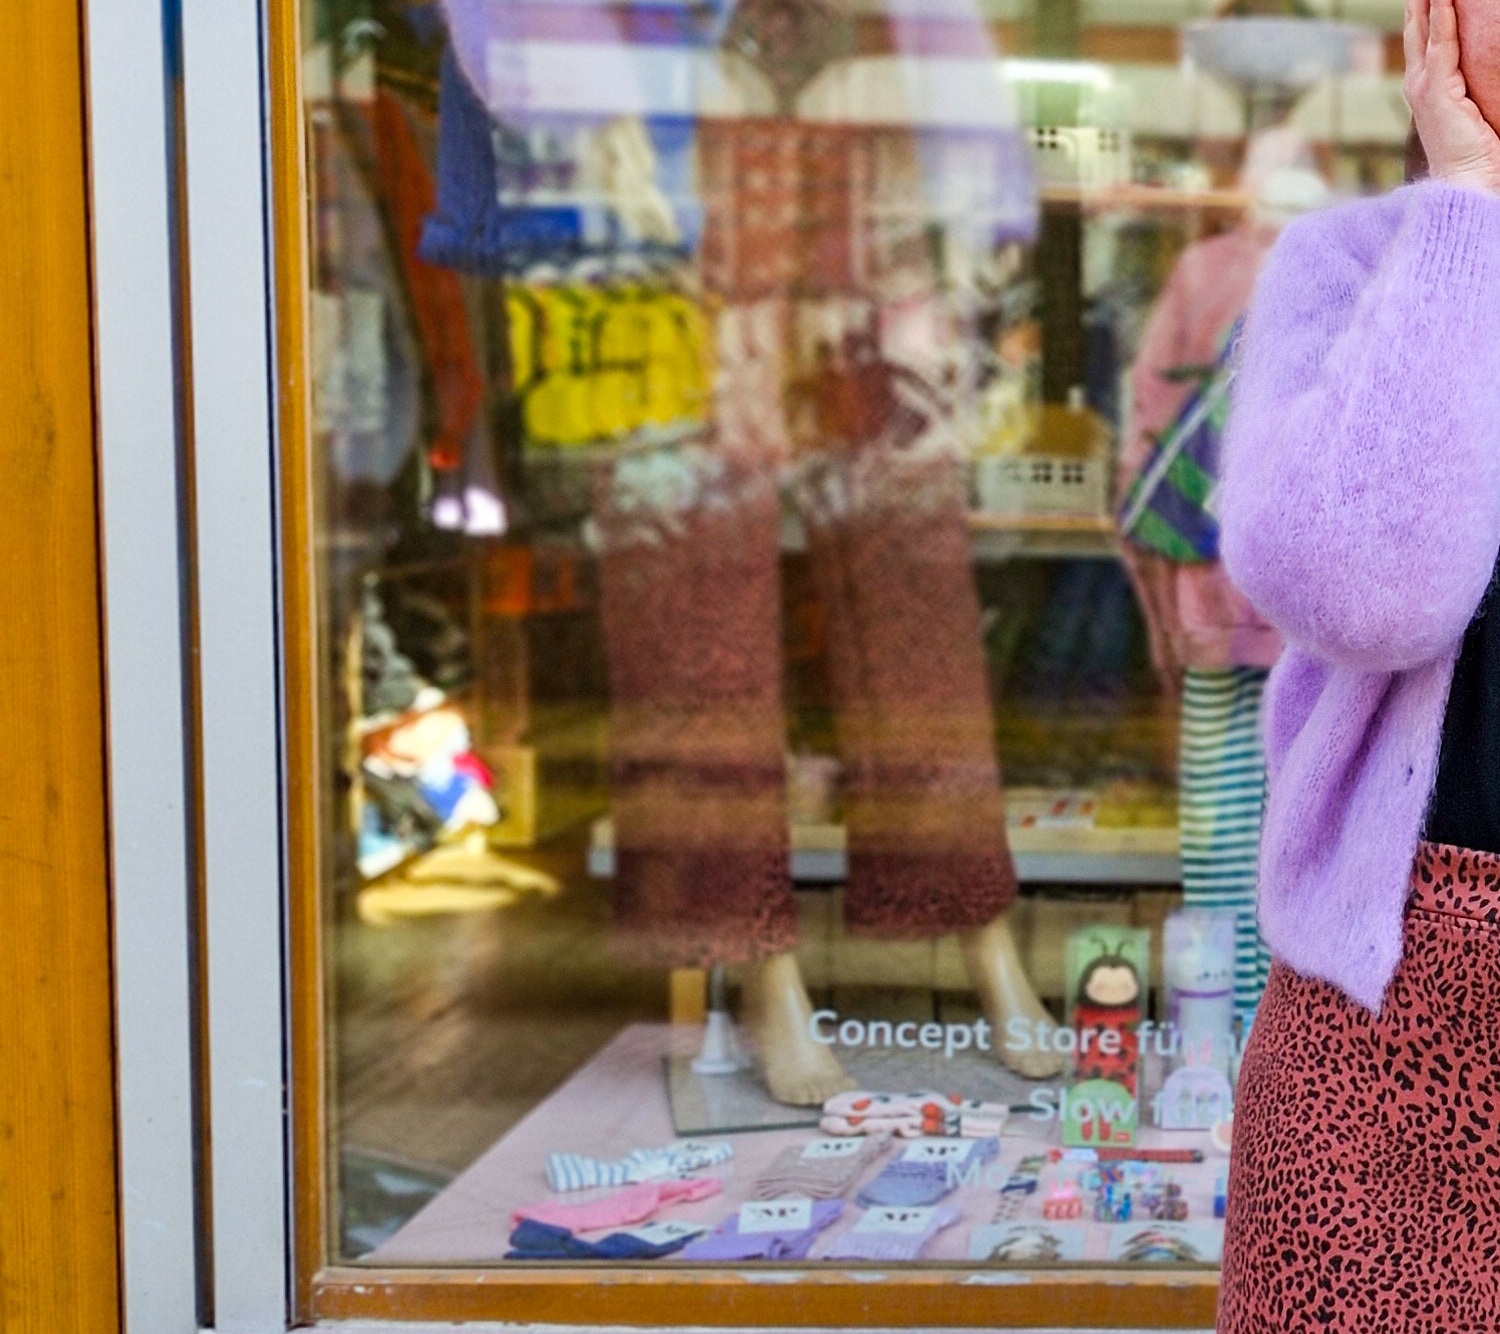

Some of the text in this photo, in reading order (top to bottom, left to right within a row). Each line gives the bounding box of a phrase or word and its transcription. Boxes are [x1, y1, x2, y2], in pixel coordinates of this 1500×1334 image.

[808, 1009, 992, 1059] Concept
[1004, 1018, 1123, 1054] Store
[1028, 1087, 1138, 1124] Slow
